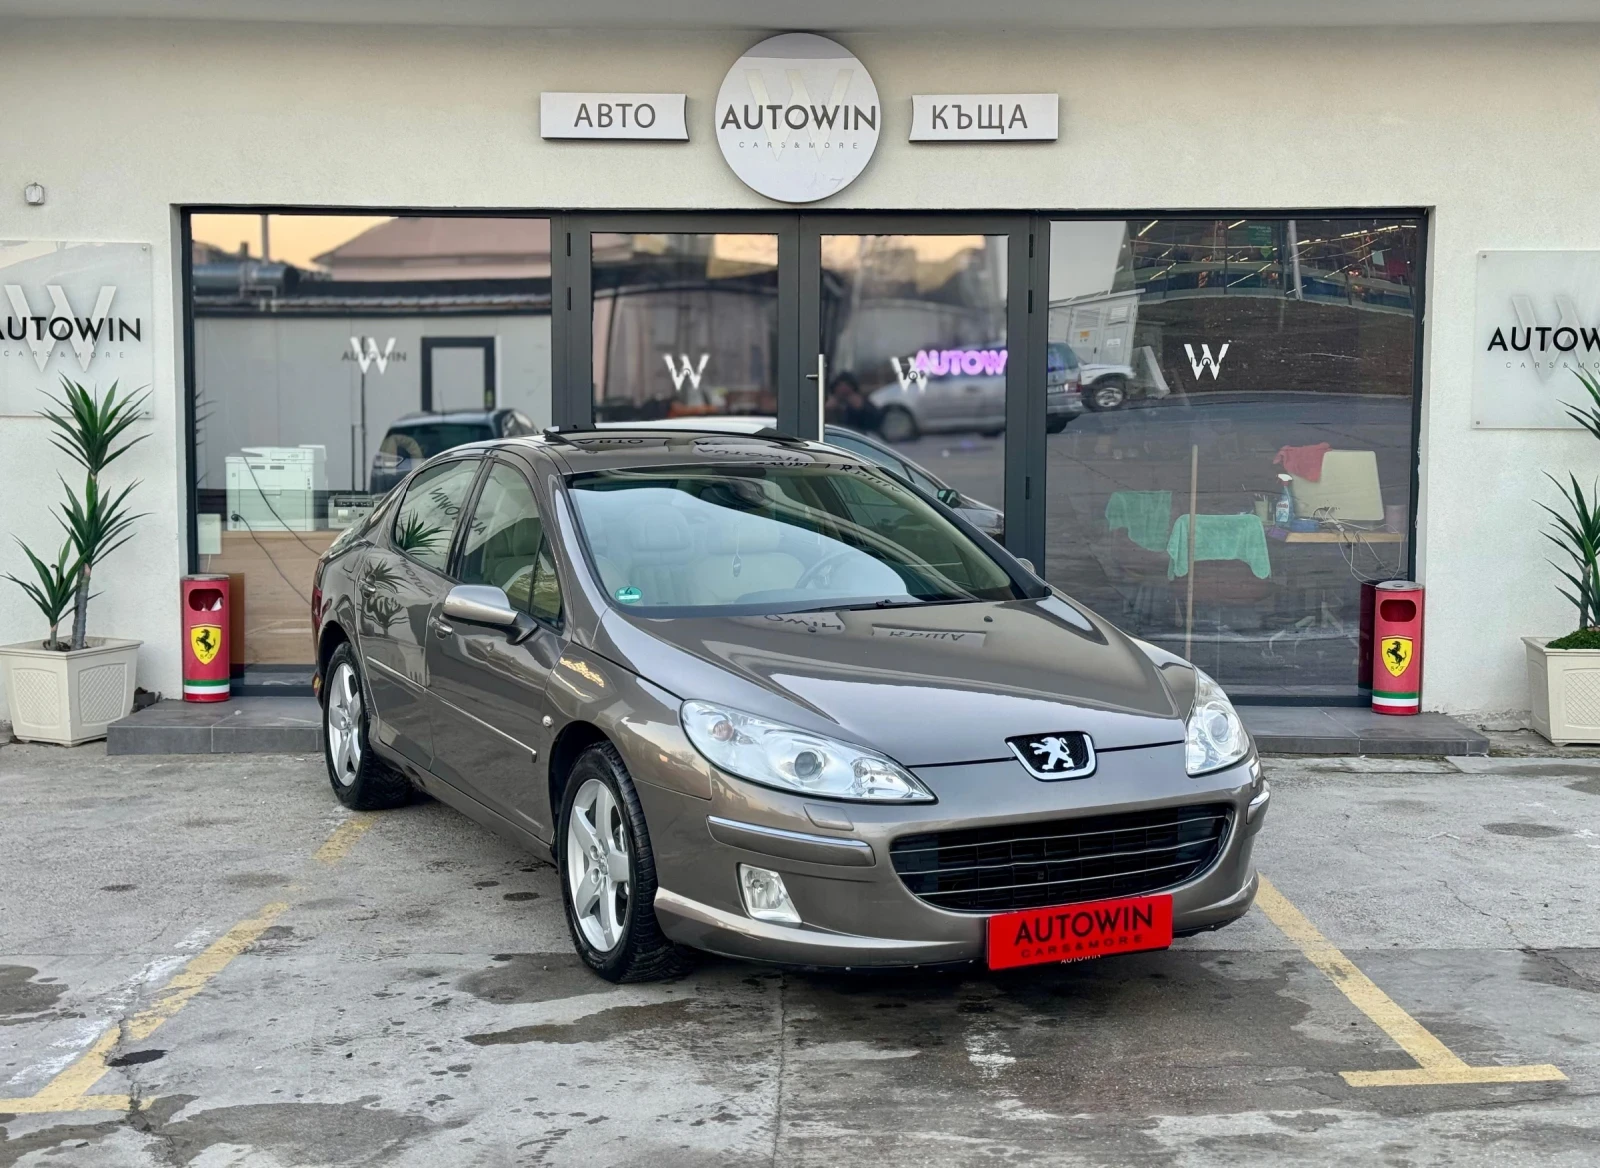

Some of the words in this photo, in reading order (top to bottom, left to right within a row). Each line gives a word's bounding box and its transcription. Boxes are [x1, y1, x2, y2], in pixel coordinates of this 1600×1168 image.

[574, 103, 656, 128] АВТО
[721, 104, 876, 131] AUTOWIN
[932, 104, 1028, 134] КЪЩА
[0, 316, 141, 342] UTOWIN
[663, 354, 709, 391] W
[1184, 344, 1229, 380] W
[1014, 904, 1153, 946] AUTOWIN
[1020, 933, 1143, 958] CARS&MORE
